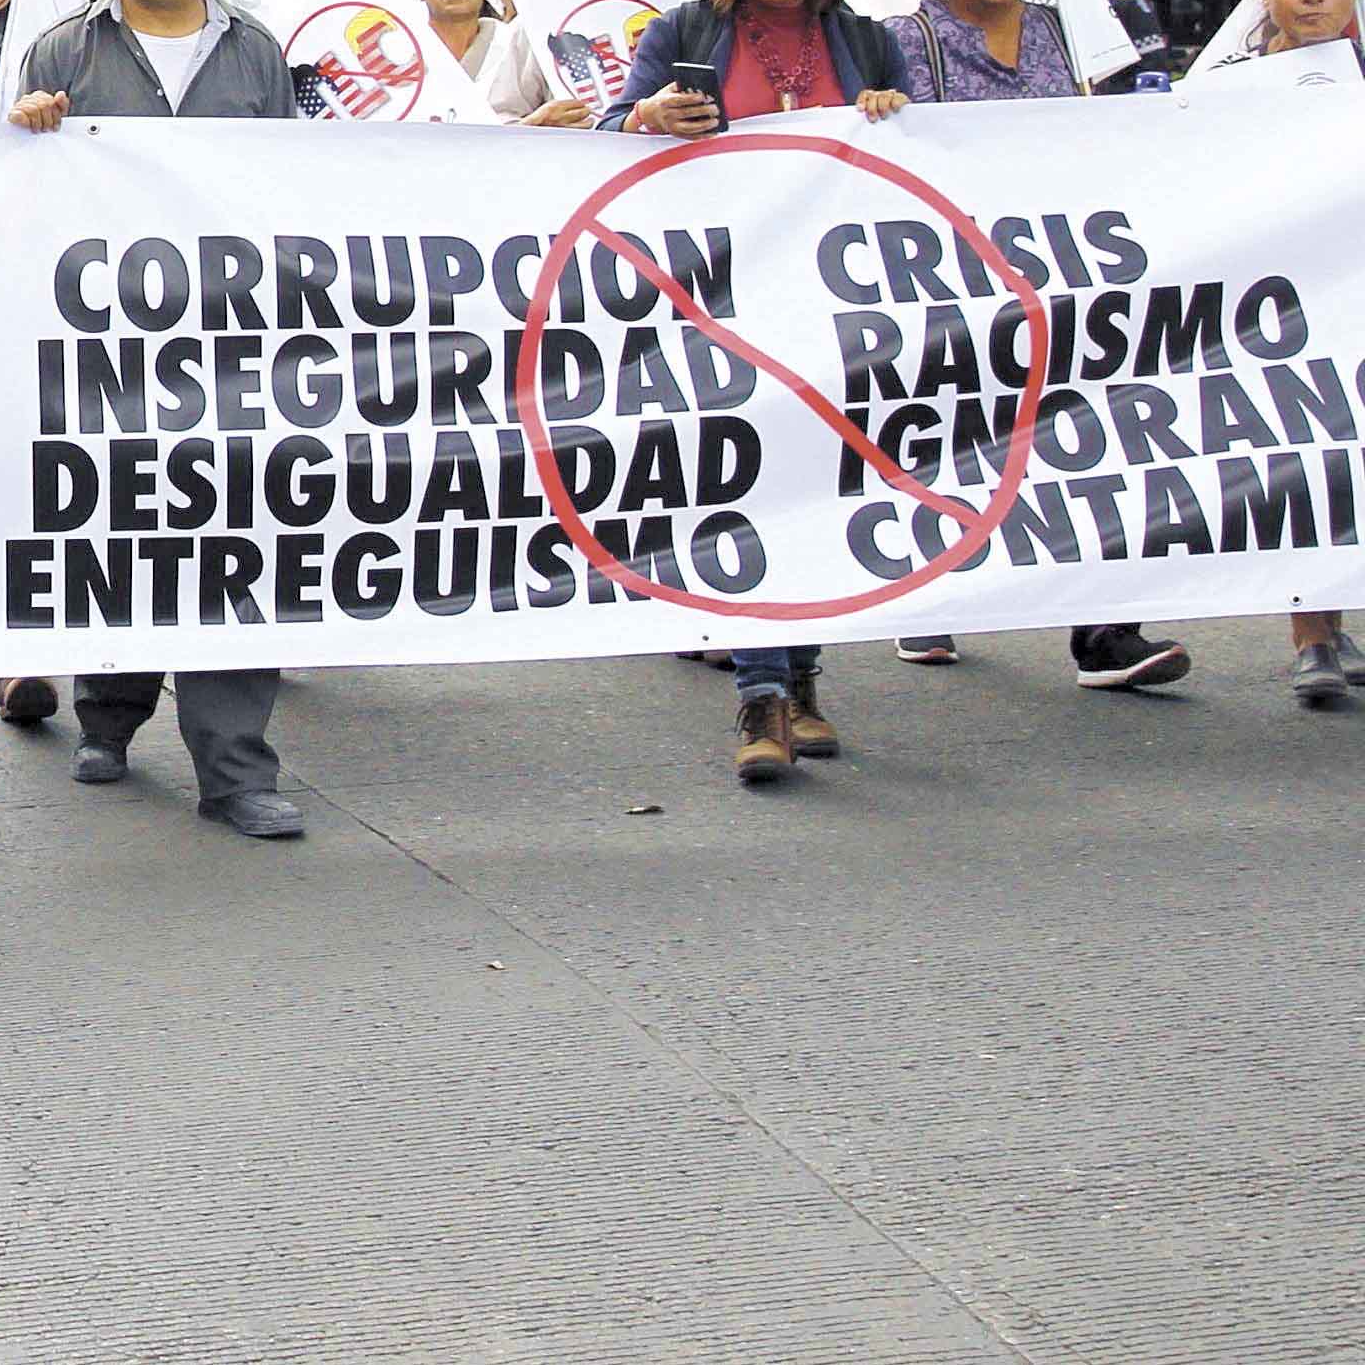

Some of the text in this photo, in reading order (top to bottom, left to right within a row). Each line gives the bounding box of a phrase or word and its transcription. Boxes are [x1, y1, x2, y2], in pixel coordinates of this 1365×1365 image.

[54, 226, 736, 334] CORRUPCION
[816, 211, 1149, 305] CRISIS
[37, 325, 759, 436] INSEGURIDAD
[832, 275, 1310, 404] RACISMO
[32, 415, 764, 533] DESIGUALDAD
[837, 357, 1365, 498] IGNORAN
[5, 511, 768, 630] ENTREGUISMO
[845, 447, 1365, 582] CONTAMI
